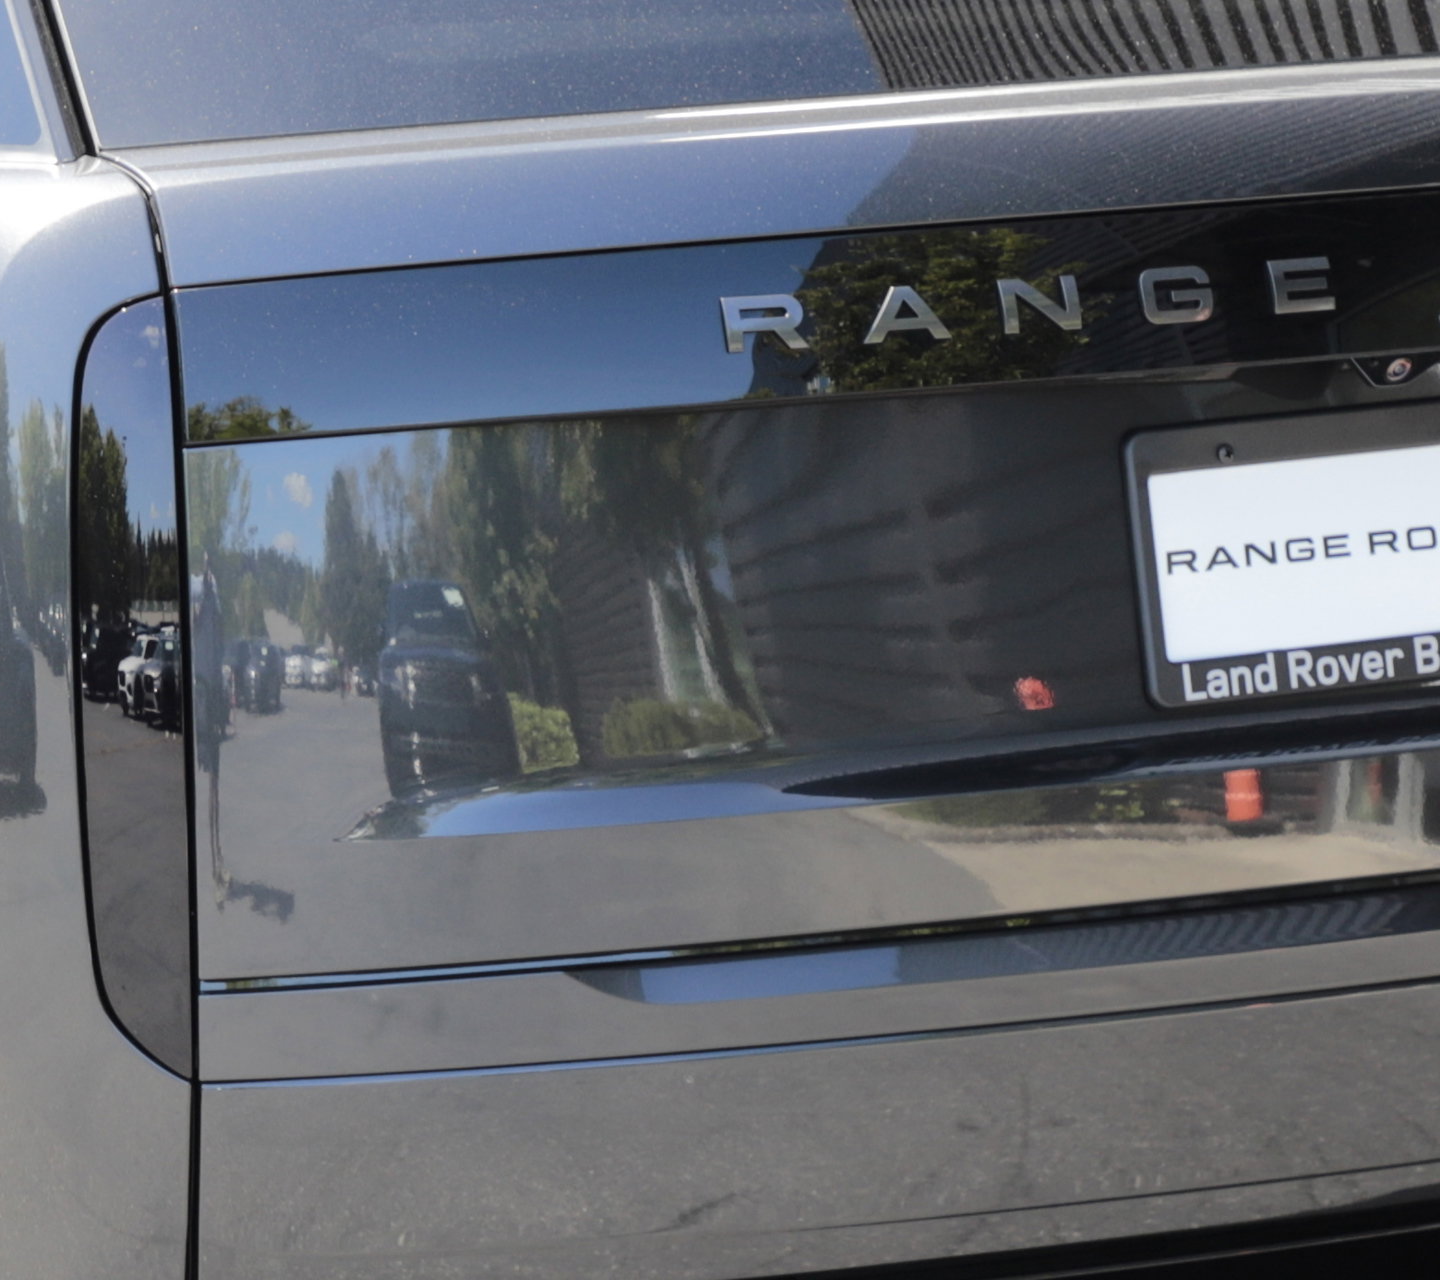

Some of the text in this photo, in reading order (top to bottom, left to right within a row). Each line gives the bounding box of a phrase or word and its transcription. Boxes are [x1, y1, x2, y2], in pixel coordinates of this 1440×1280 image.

[720, 255, 1337, 354] RANGE
[1166, 533, 1352, 575] RANGE
[1181, 652, 1279, 703] Land
[1286, 646, 1405, 691] Rover
